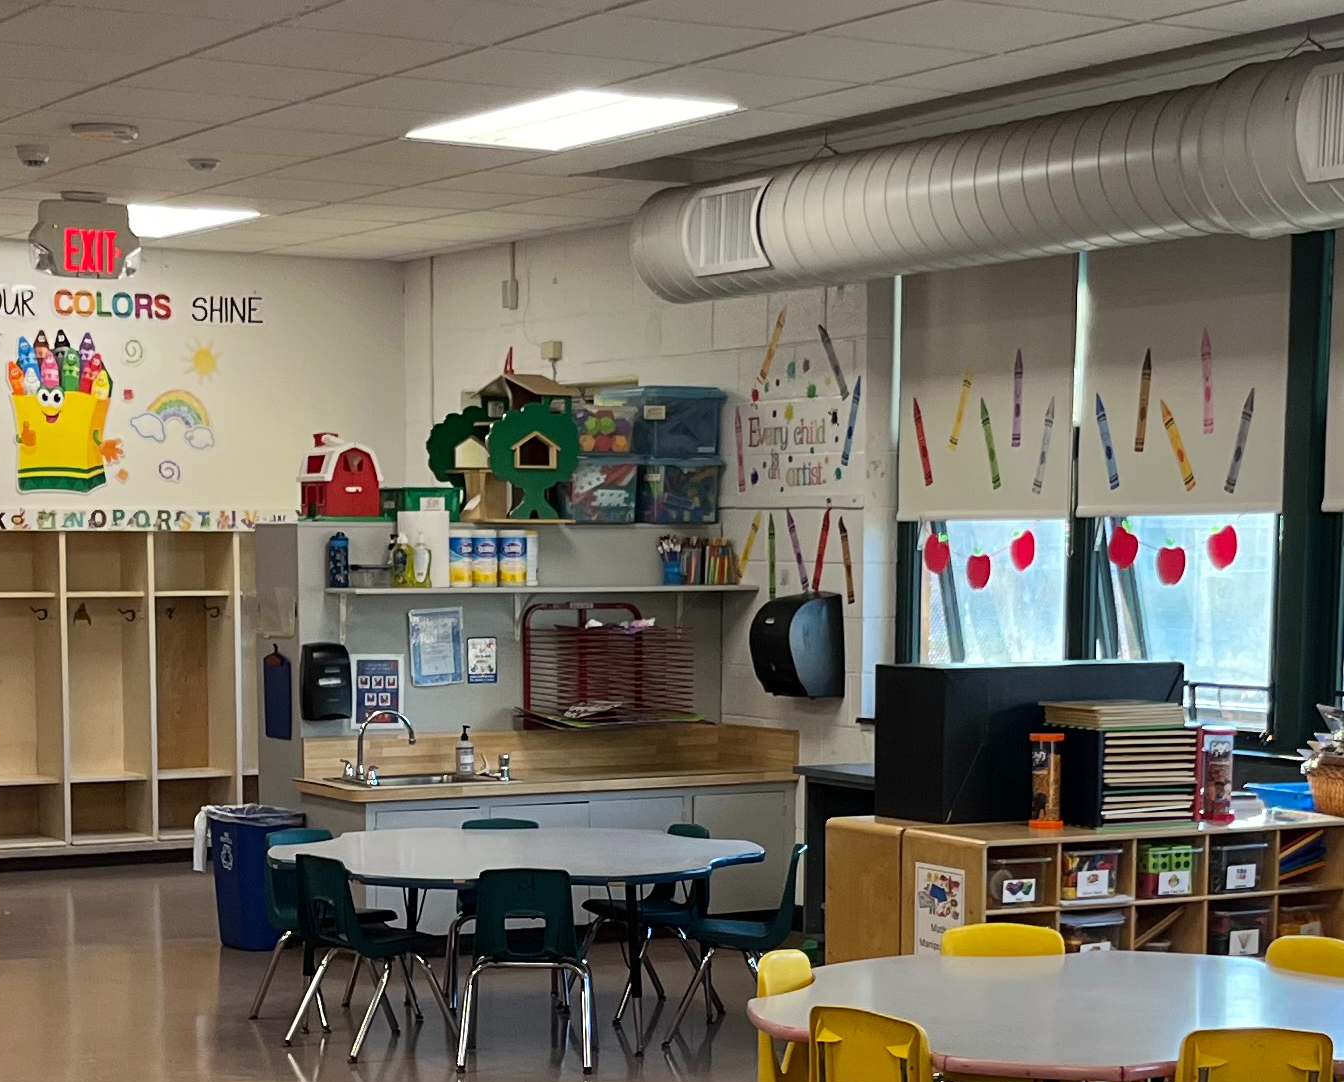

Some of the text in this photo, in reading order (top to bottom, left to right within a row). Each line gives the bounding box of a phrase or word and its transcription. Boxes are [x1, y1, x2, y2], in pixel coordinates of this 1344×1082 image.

[64, 228, 117, 274] EXIT
[54, 289, 173, 321] COLORS
[191, 296, 264, 324] SHINE
[748, 417, 826, 451] Every child
